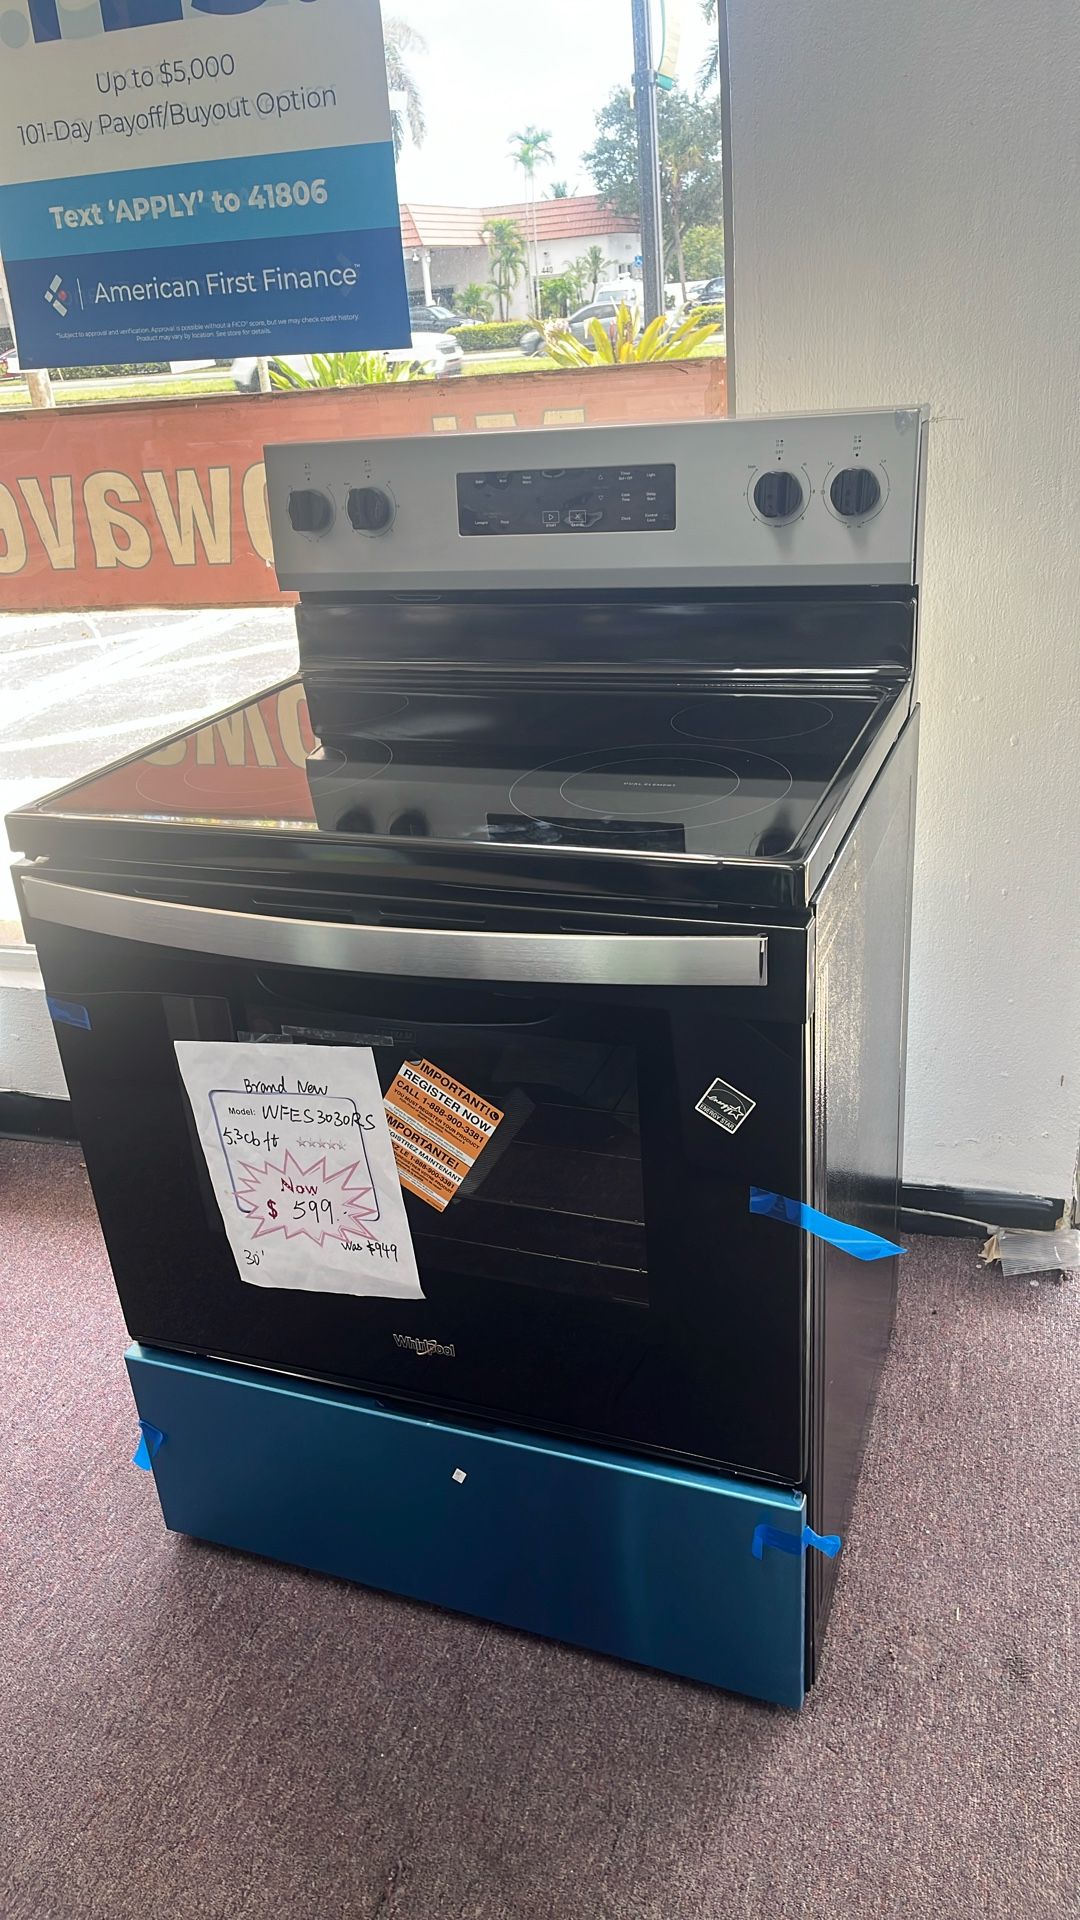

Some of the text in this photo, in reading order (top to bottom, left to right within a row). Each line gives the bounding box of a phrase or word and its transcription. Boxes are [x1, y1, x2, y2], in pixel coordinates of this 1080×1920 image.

[96, 53, 235, 97] Up to $5,000
[17, 86, 337, 146] 101-Day Payoff/Buyout Option
[48, 203, 104, 229] Text
[211, 190, 241, 214] to
[248, 178, 328, 209] 41806
[94, 276, 200, 304] American
[205, 271, 257, 295] First
[85, 330, 108, 338] approval
[151, 325, 175, 334] Approval
[181, 323, 204, 332] possible
[288, 318, 301, 326] may
[172, 334, 184, 342] vary
[184, 333, 191, 341] by
[243, 1076, 328, 1096] Brand New
[402, 1068, 462, 1113] REGISTER
[461, 1108, 492, 1133] NOW
[419, 1062, 491, 1115] IMPORTANT!
[228, 1107, 256, 1116] Model:
[392, 1088, 405, 1098] YOU
[403, 1095, 418, 1107] MUST
[417, 1104, 442, 1124] REGISTER
[441, 1121, 457, 1134] YOUR
[455, 1130, 480, 1150] PRODUCT
[395, 1078, 422, 1100] CALL
[420, 1096, 485, 1143] 1-888-900-3381
[699, 1104, 735, 1130] ENERGY STAR
[263, 1131, 280, 1151] ft
[398, 1148, 410, 1158] LE
[408, 1155, 455, 1189] 1-888-900-3381
[417, 1150, 462, 1183] MAINTENANT
[281, 1176, 318, 1196] Now
[266, 1198, 278, 1220] $
[341, 1240, 398, 1263] Was $949
[392, 1333, 456, 1357] Whirlpool
